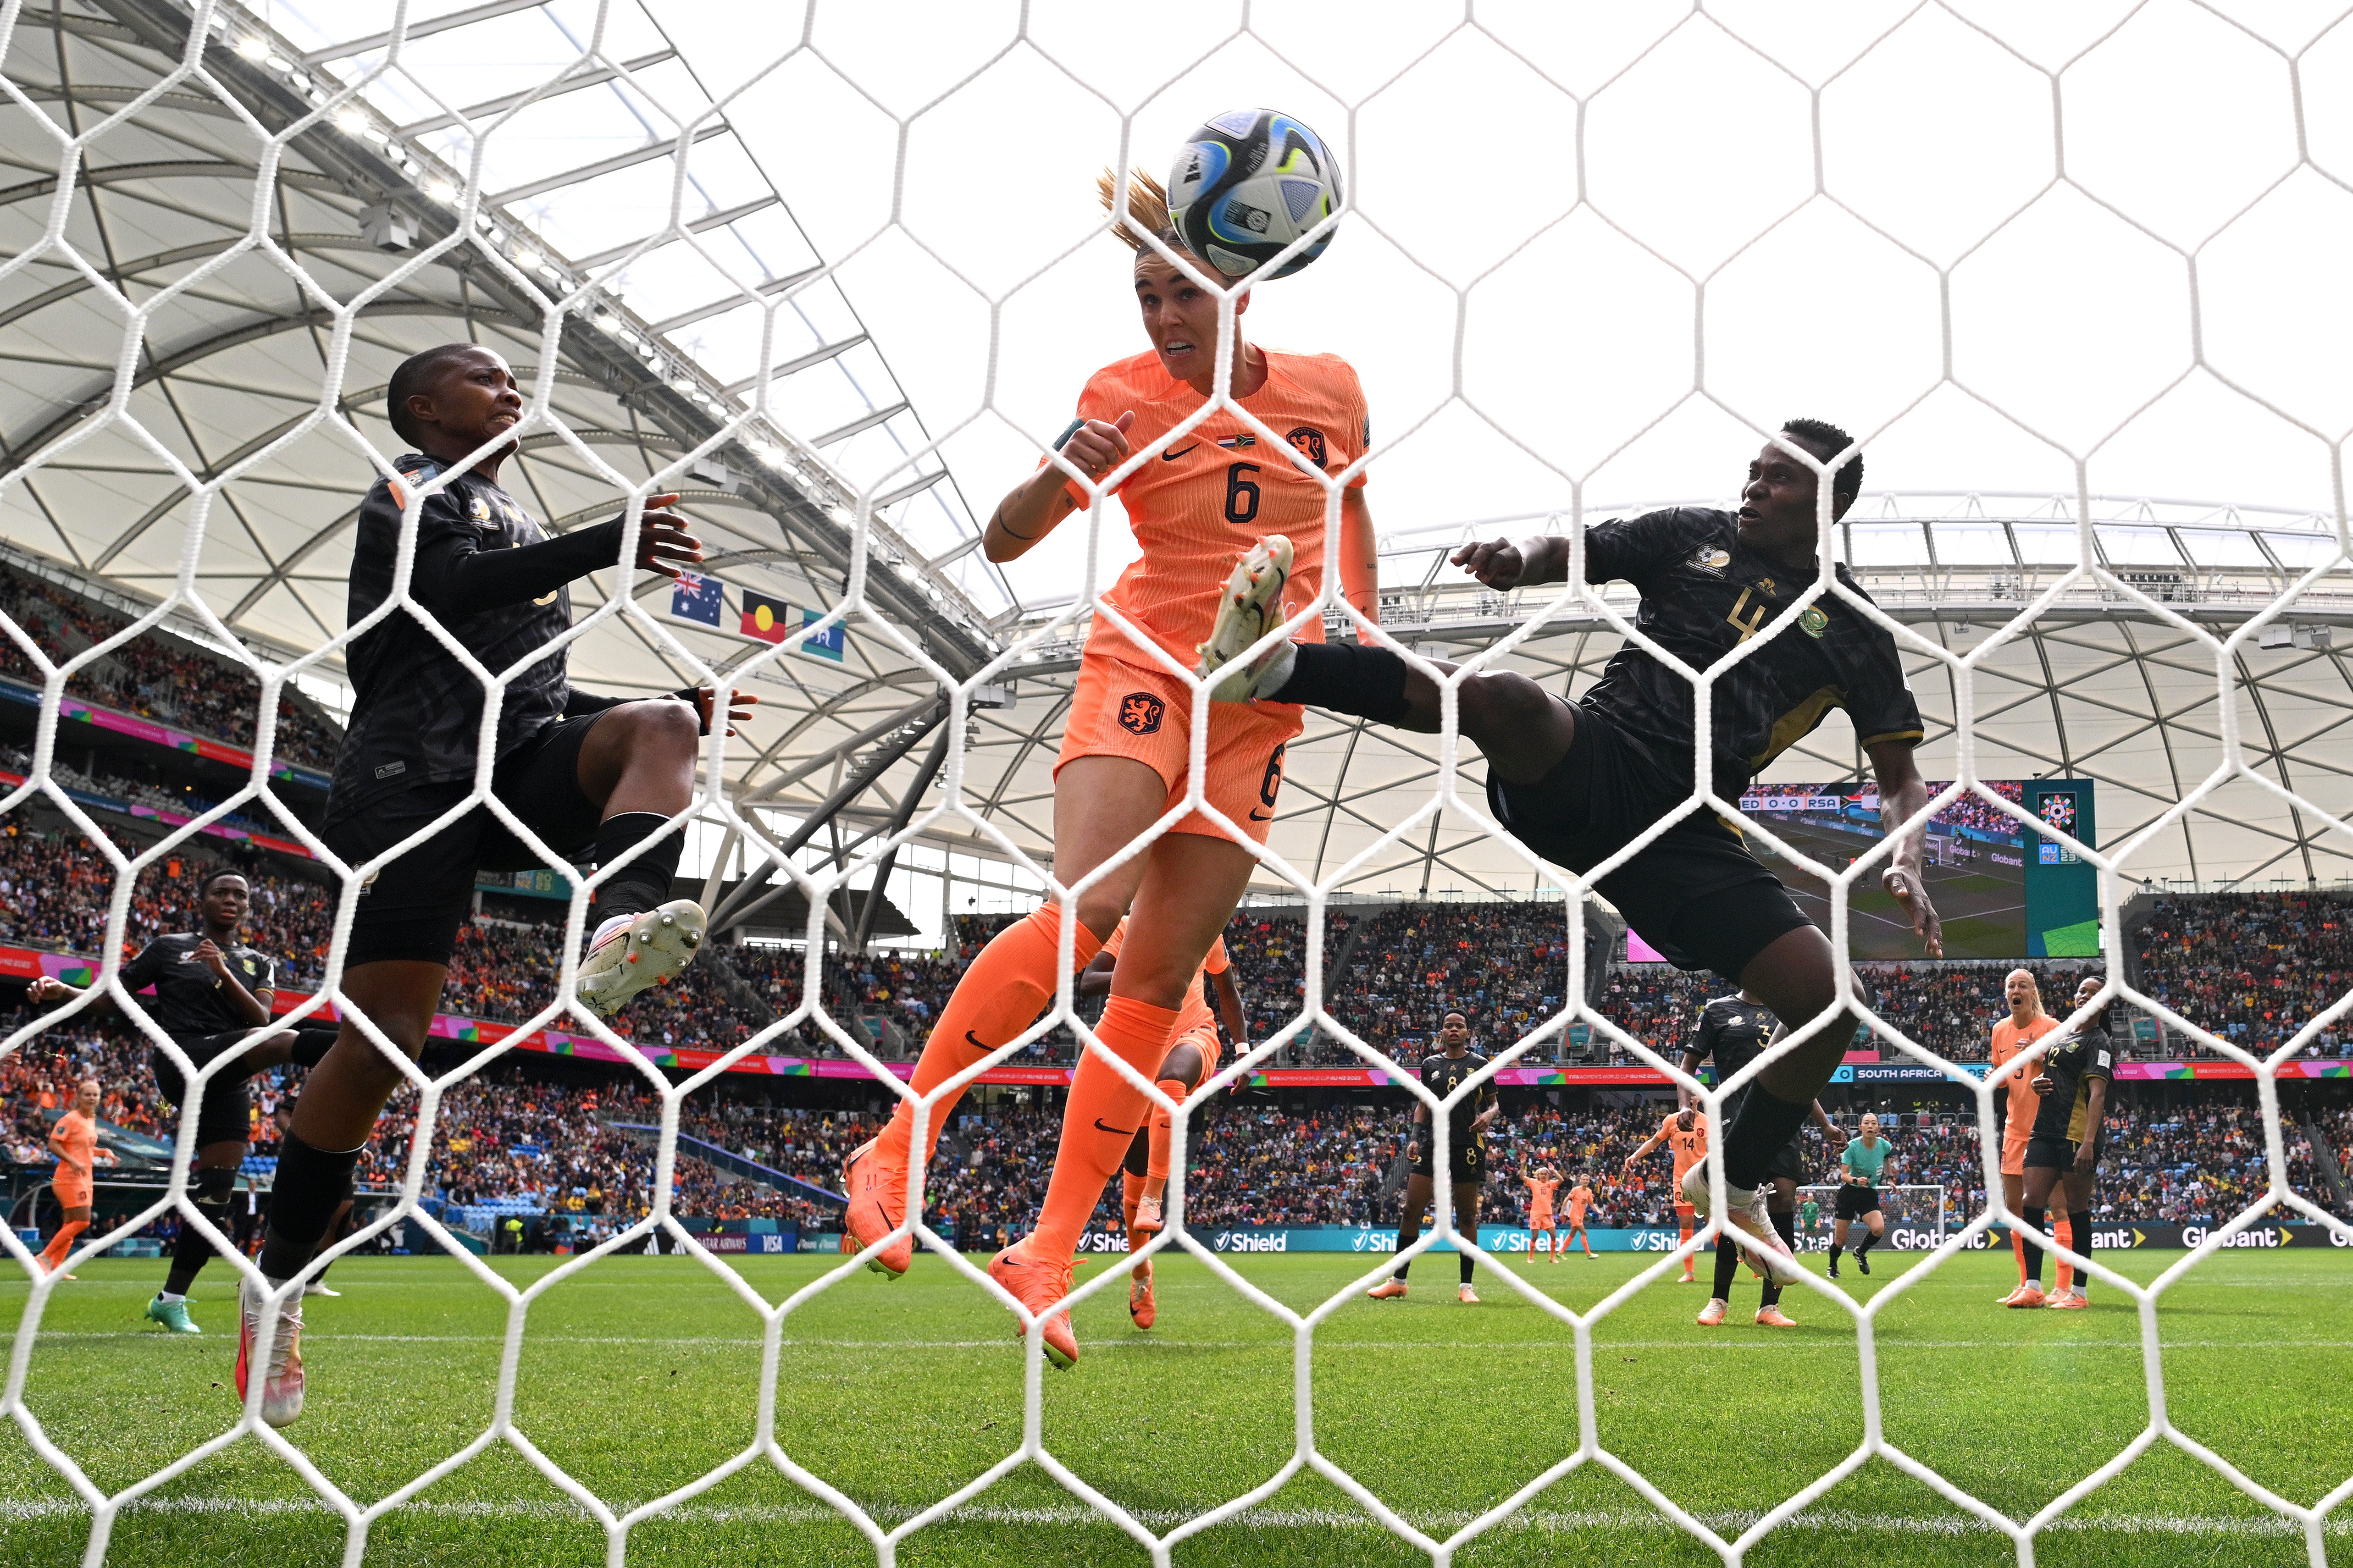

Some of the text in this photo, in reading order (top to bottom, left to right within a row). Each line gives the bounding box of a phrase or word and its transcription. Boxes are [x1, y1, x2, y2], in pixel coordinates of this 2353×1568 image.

[1225, 462, 1260, 523] 6
[1726, 587, 1766, 647] 4
[1800, 622, 1809, 632] SOUTH
[1260, 743, 1284, 808] 6
[1991, 853, 2023, 867] Globant
[1757, 1025, 1771, 1048] 3
[1858, 1070, 1897, 1078] SOUTH
[1900, 1069, 1942, 1077] AFRICA
[1447, 1076, 1458, 1093] 8
[1682, 1137, 1694, 1151] 14
[1467, 1147, 1477, 1165] 8
[720, 1237, 747, 1250] AIRWAYS
[762, 1234, 783, 1252] VISA
[1093, 1233, 1130, 1252] Shie
[1231, 1232, 1286, 1252] Shield
[1369, 1233, 1397, 1252] Shi
[1509, 1233, 1564, 1251] Sheld
[2182, 1226, 2278, 1248] Glbant
